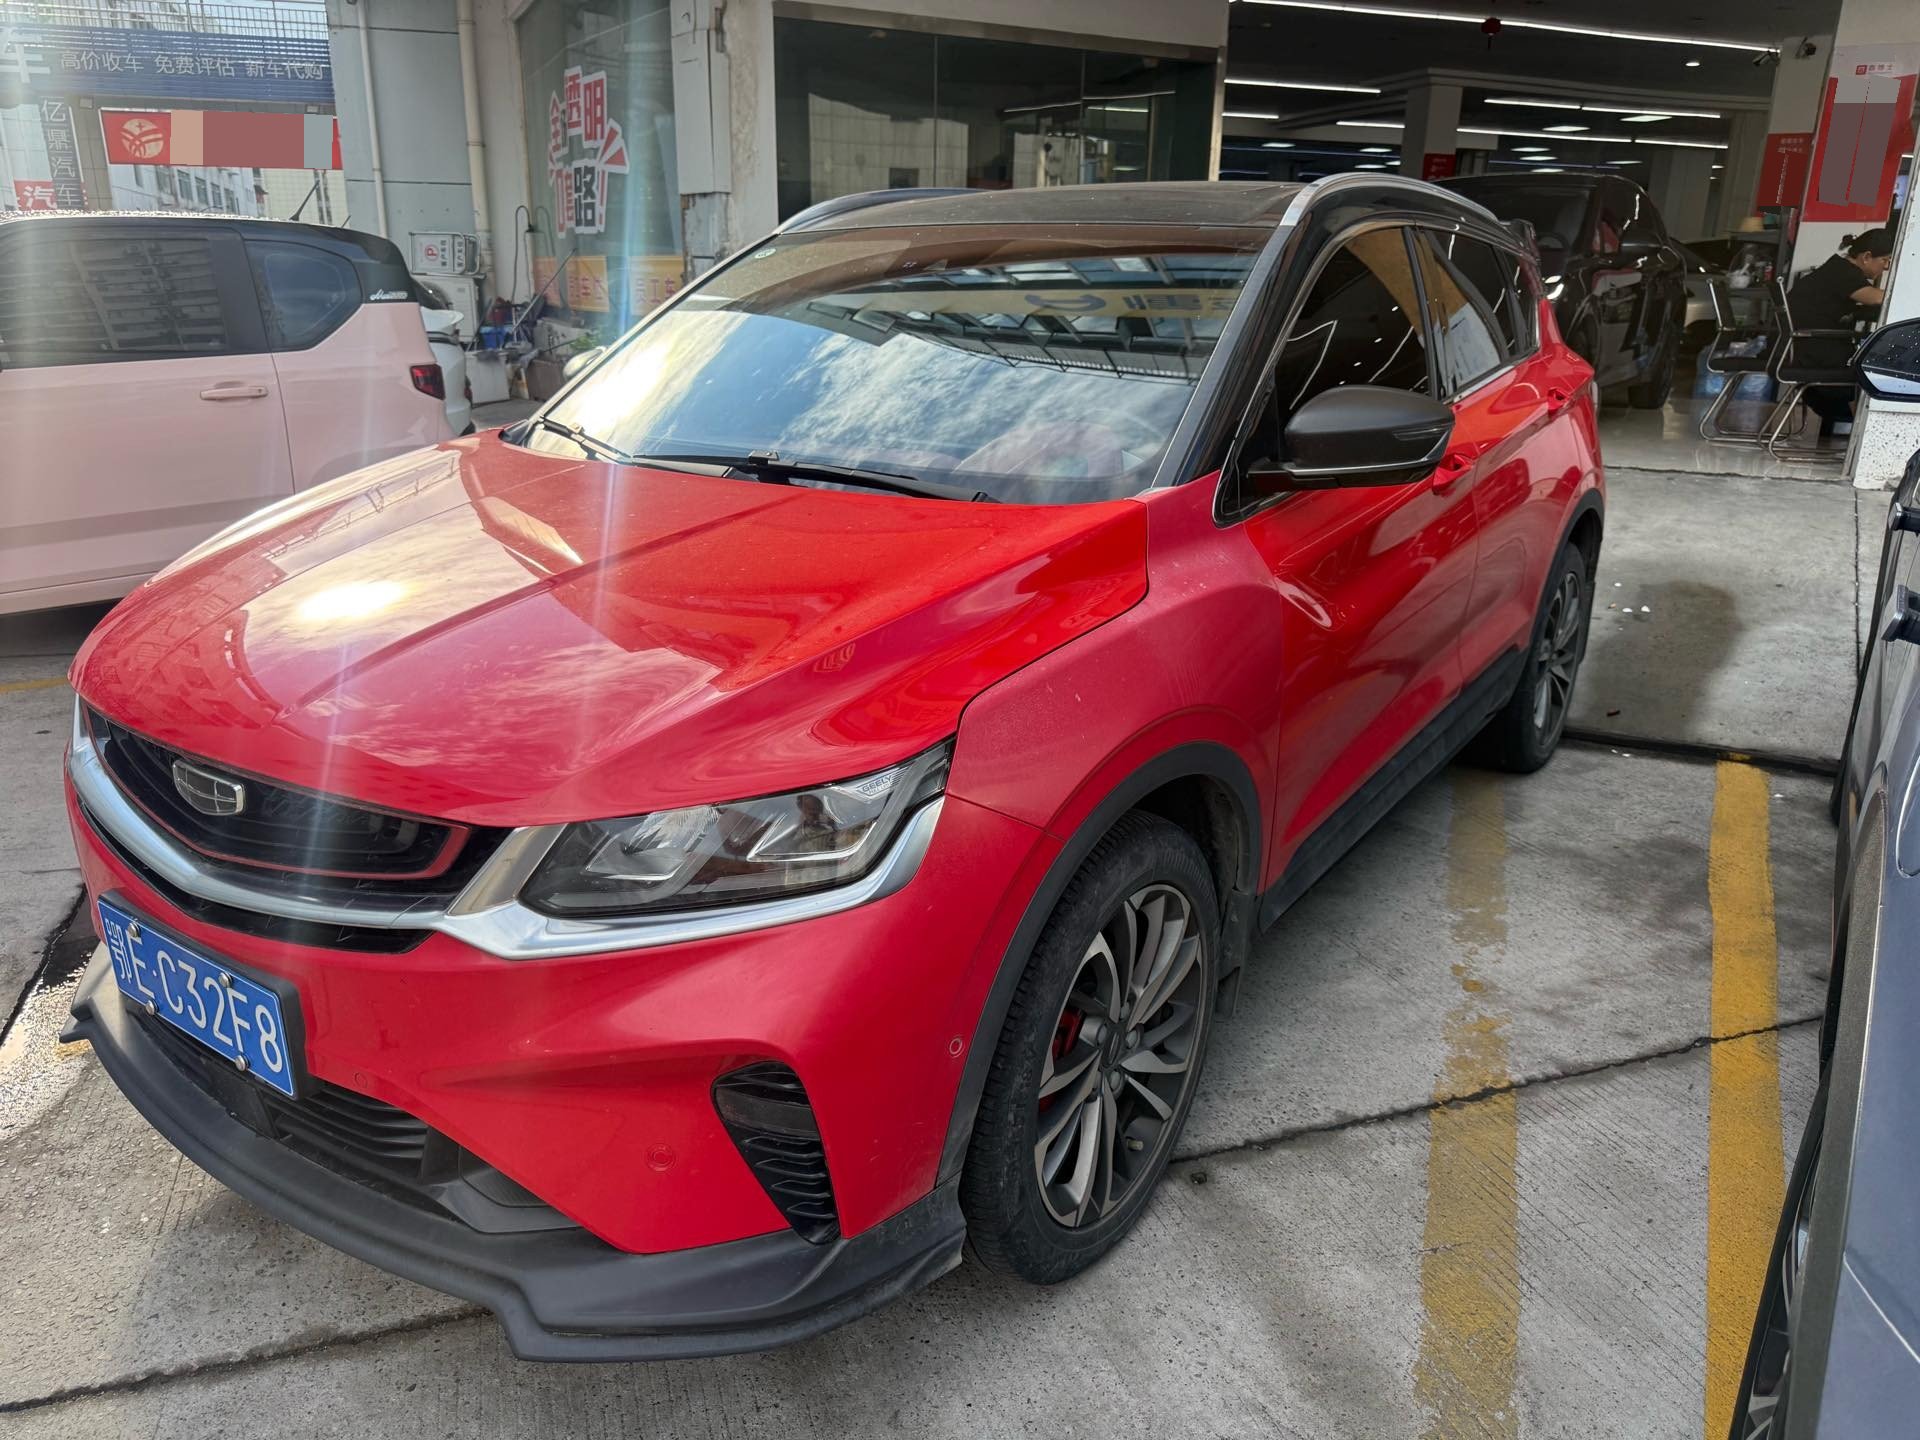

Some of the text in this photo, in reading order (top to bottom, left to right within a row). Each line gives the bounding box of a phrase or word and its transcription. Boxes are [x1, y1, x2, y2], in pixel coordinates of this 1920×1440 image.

[60, 50, 323, 80] 高价收车 免费评估 新车代购
[41, 98, 81, 207] 亿鼎汽车
[862, 775, 892, 792] GEELY
